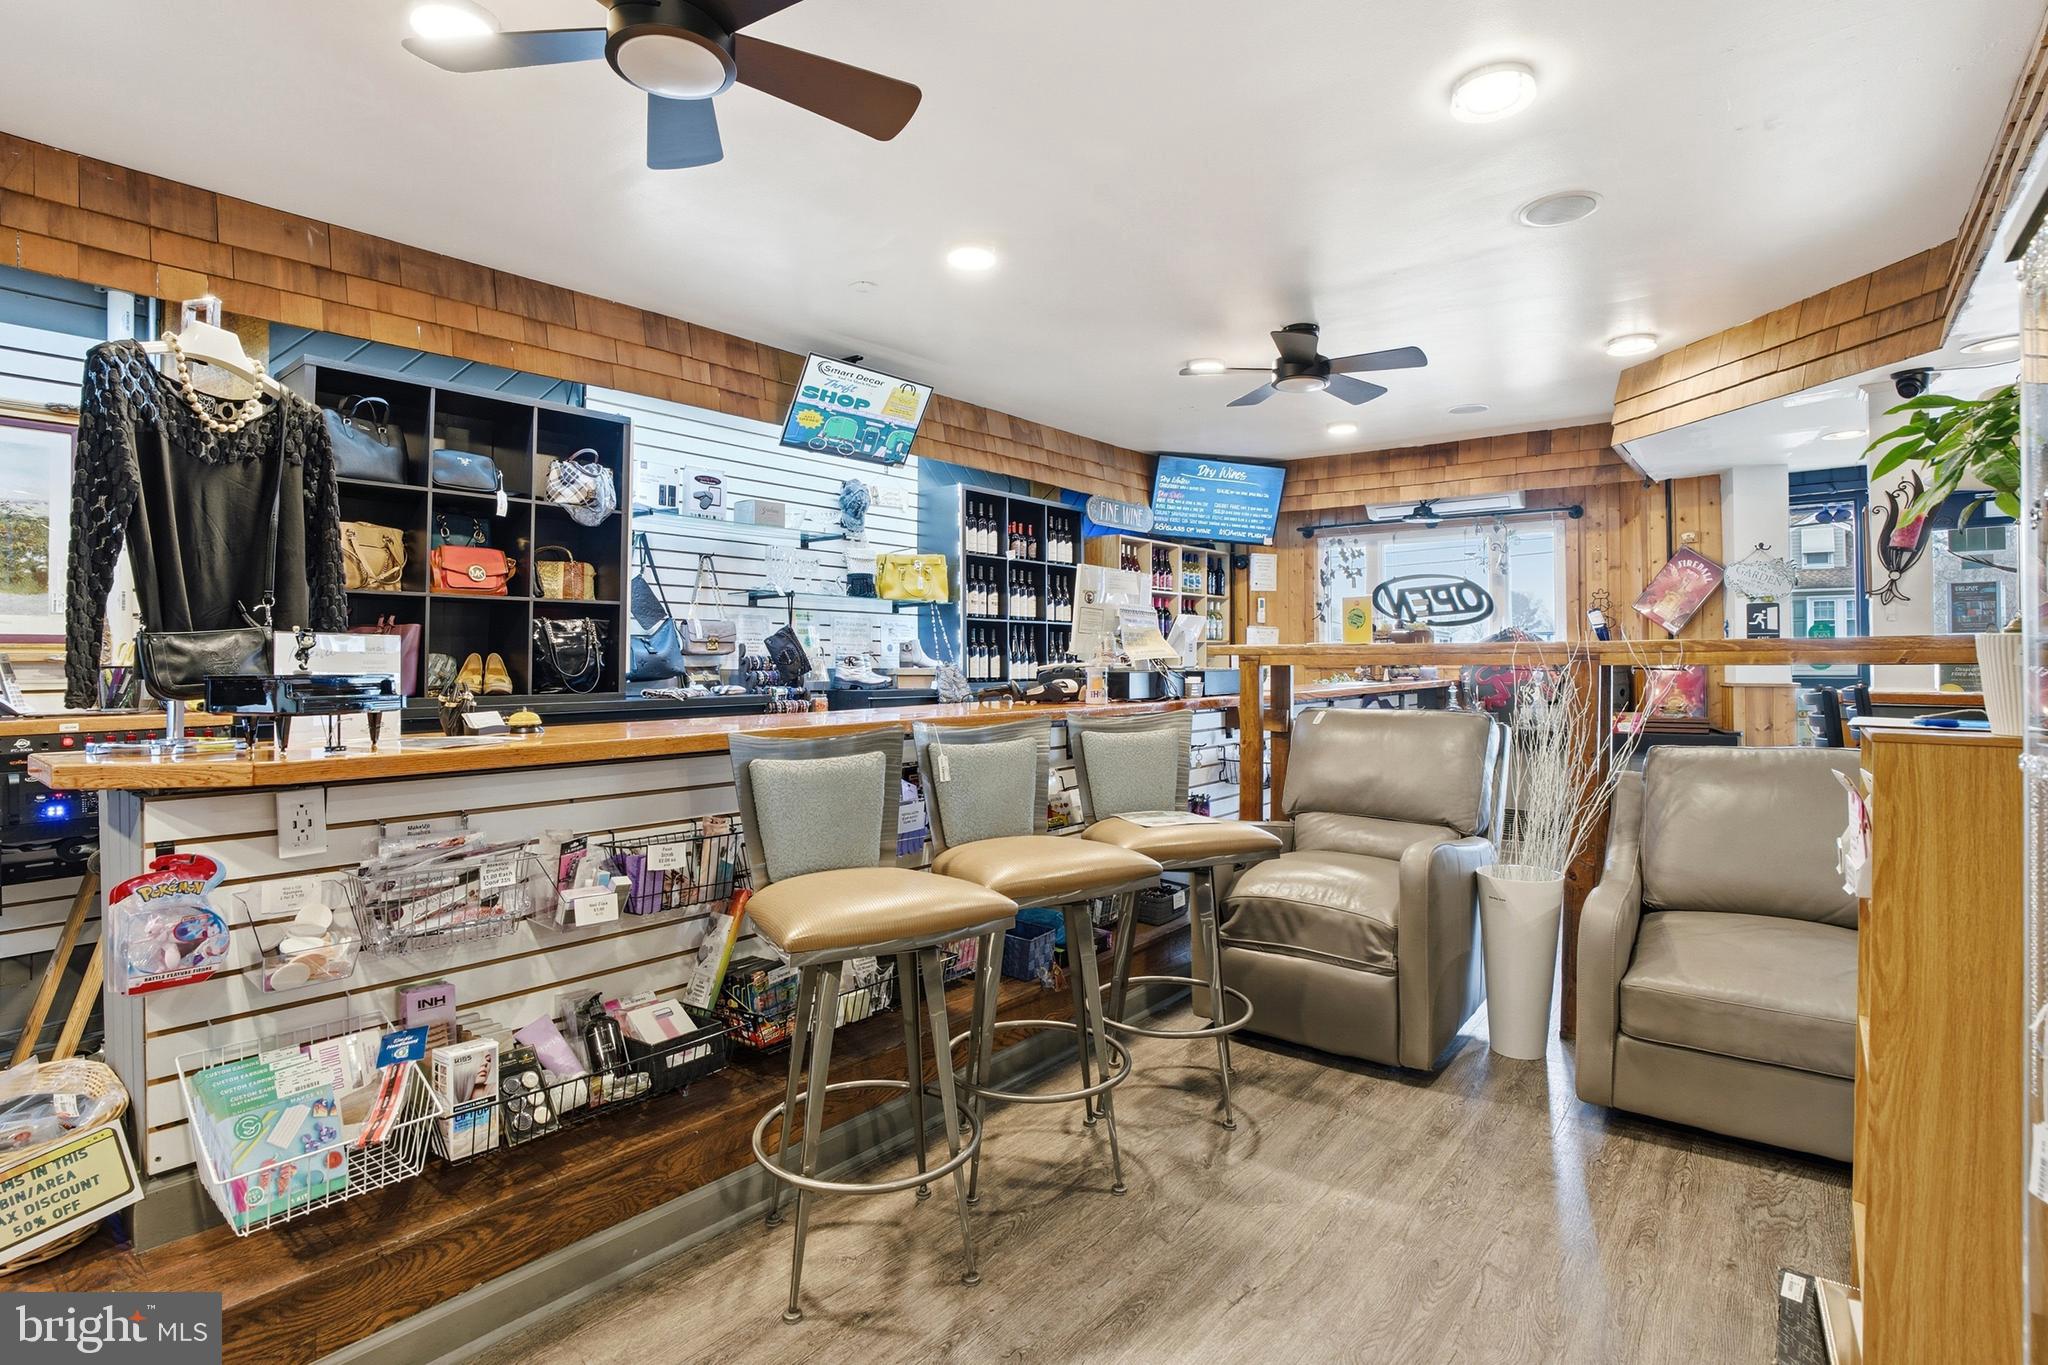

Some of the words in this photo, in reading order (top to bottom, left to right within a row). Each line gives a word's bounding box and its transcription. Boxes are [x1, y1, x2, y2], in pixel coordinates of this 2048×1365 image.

[823, 365, 855, 378] Smart
[856, 374, 886, 387] Decor
[824, 377, 858, 393] Thrift
[801, 385, 871, 410] SHOP
[1198, 465, 1217, 478] Dry
[1220, 466, 1248, 480] Wines
[1100, 501, 1120, 523] FINE
[1122, 505, 1144, 527] WINE
[1677, 560, 1714, 584] FIREBALL
[144, 974, 166, 982] BATTLE
[166, 970, 191, 979] FEATURE
[417, 995, 447, 1009] INH
[204, 1067, 232, 1079] CUSTOM
[212, 1075, 240, 1088] CUSTOM
[219, 1083, 248, 1096] CUSTOM
[229, 1091, 258, 1103] CUSTOM
[31, 1164, 48, 1181] IN
[52, 1147, 89, 1171] THIS
[24, 1173, 101, 1216] DISCOUNT
[13, 1216, 47, 1238] 50%
[52, 1199, 82, 1220] OFF
